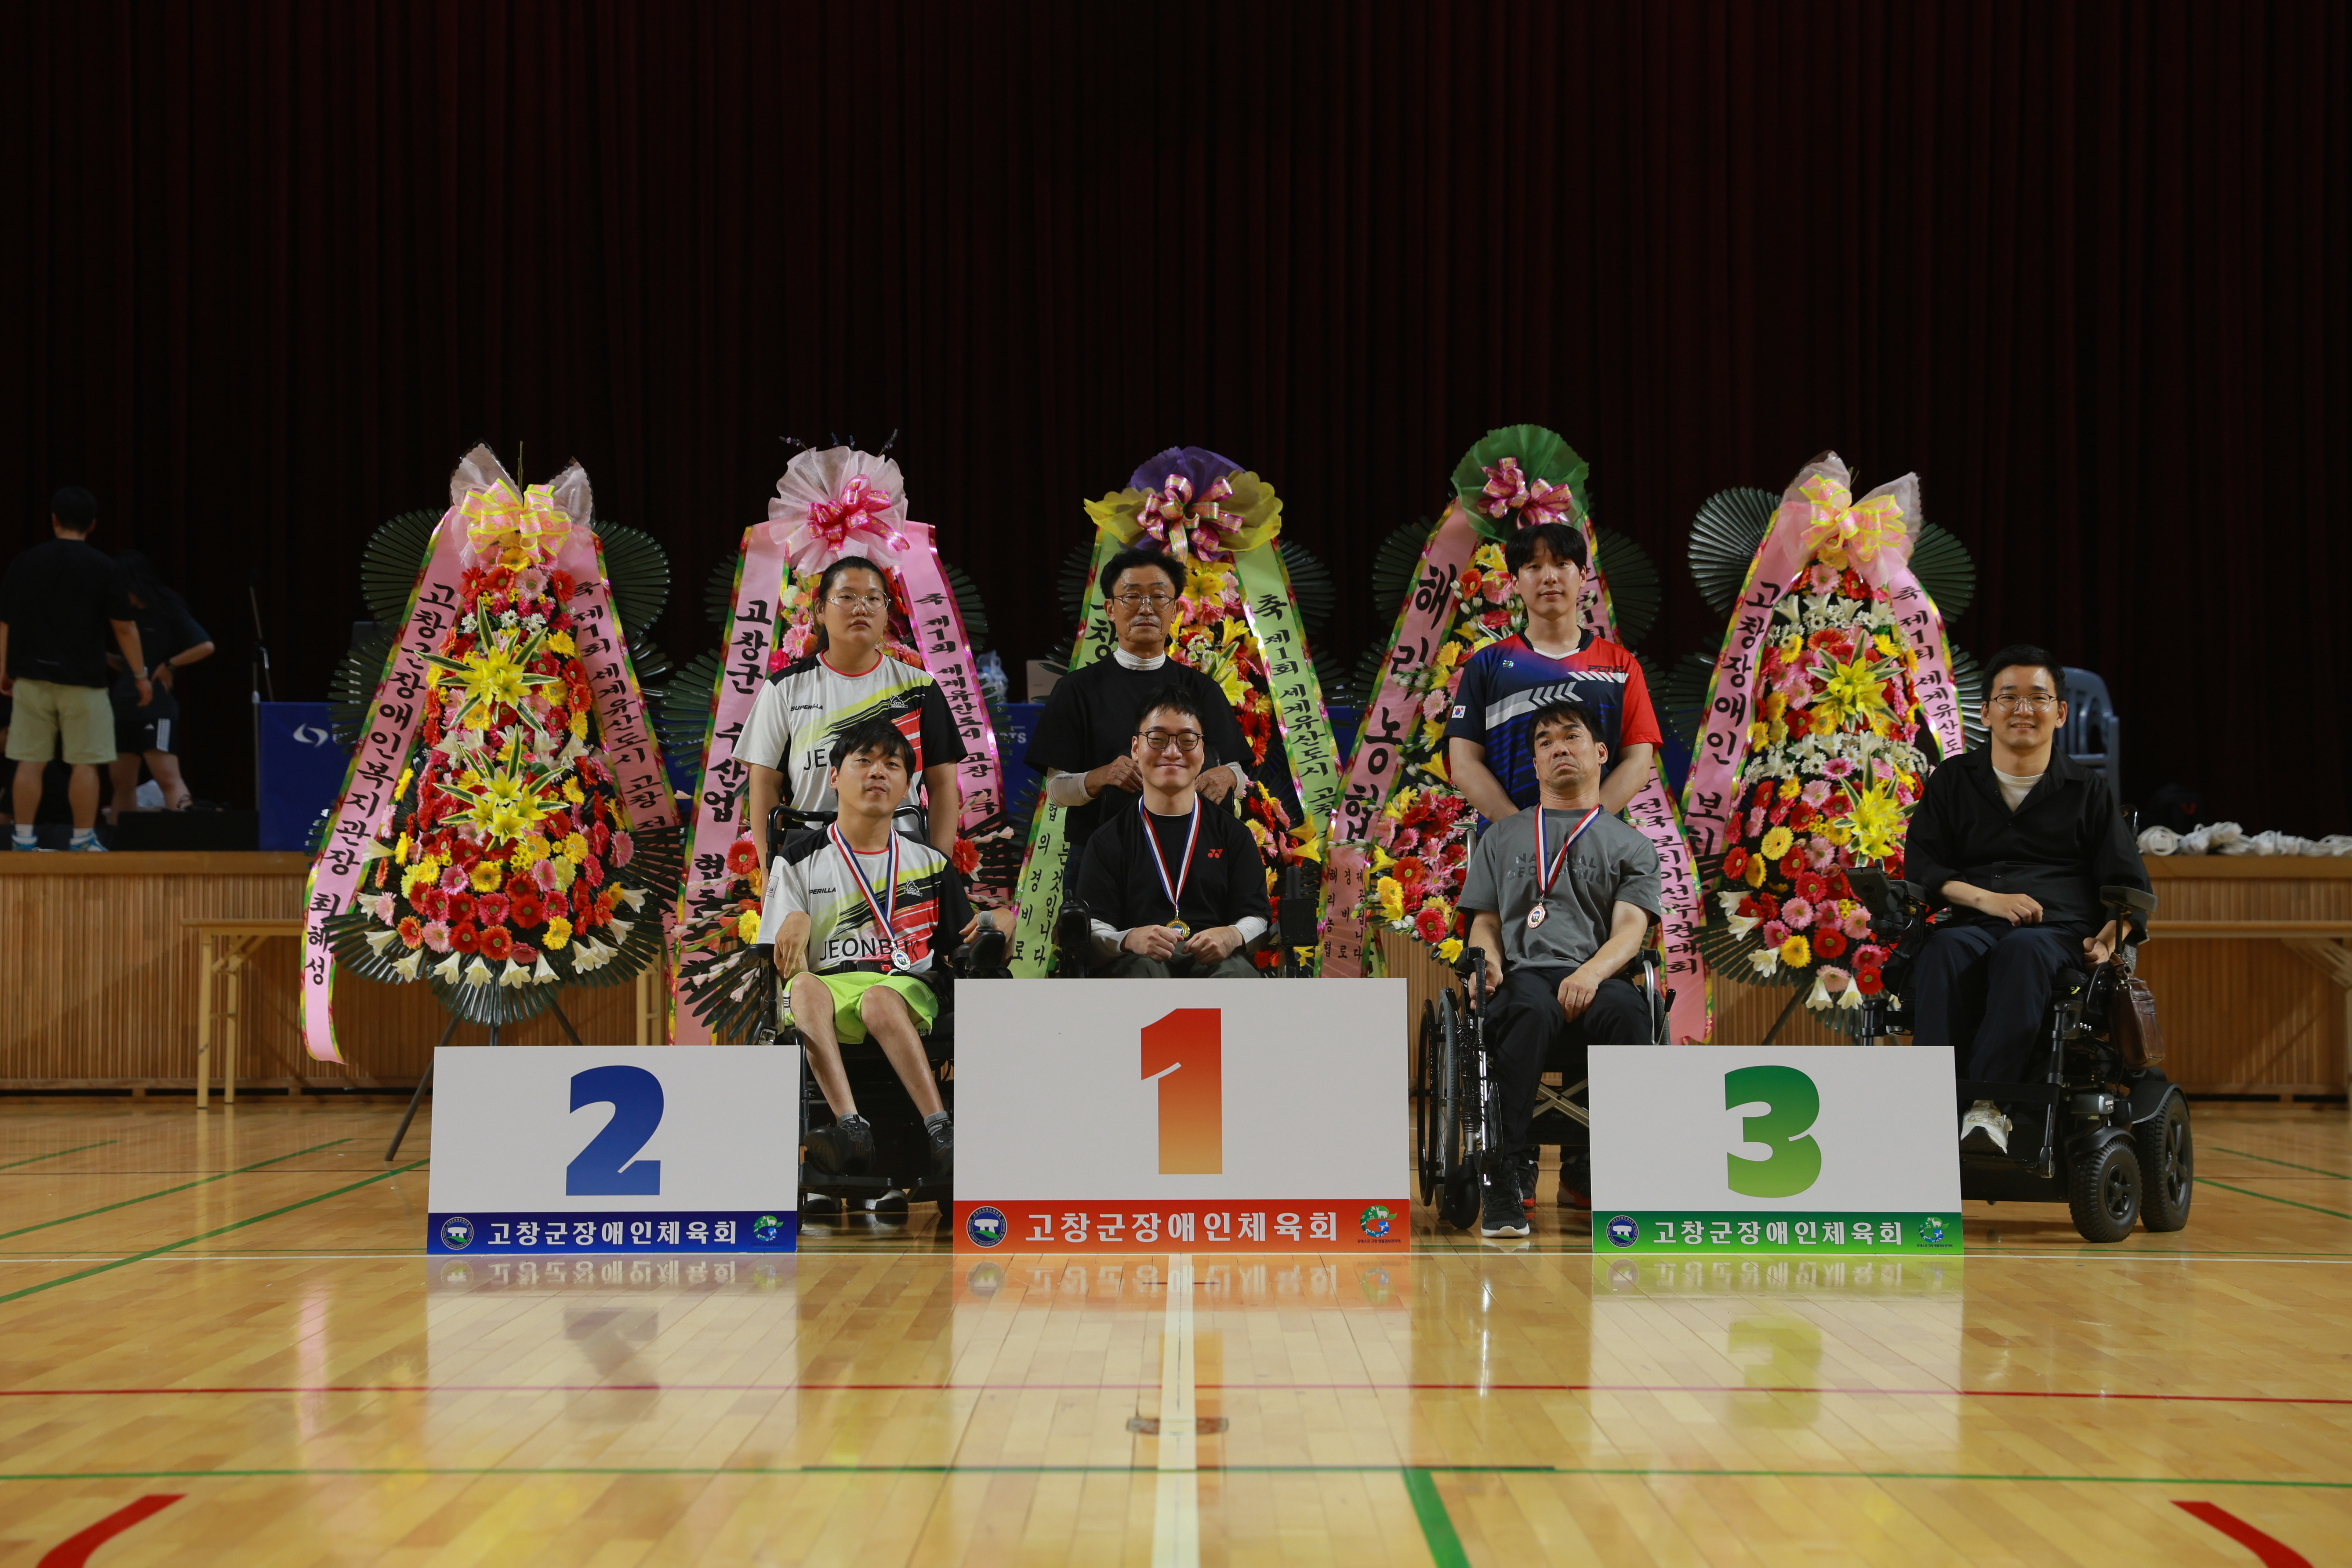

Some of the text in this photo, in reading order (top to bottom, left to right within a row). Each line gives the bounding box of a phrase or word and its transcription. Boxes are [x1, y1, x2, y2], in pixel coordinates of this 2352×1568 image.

[914, 593, 948, 605] 축
[1253, 593, 1288, 620] 축
[1893, 586, 1922, 601] 축
[573, 605, 610, 657] 제1회
[921, 615, 956, 653] 제1회
[1264, 629, 1299, 676] 제1회
[1898, 610, 1934, 661] 제1회
[1706, 581, 1781, 765] 고창장애인
[590, 662, 648, 765] 세계유산도시
[934, 663, 983, 740] 세계유산도시
[1345, 563, 1457, 842] 해리농협
[324, 583, 456, 876] 고창군장애인복지관장
[1279, 683, 1330, 777] 세계유산도시
[704, 722, 746, 822] 수산업
[959, 752, 993, 778] 고창
[624, 775, 663, 808] 고창
[1630, 798, 1674, 828] 전국
[1324, 867, 1338, 958] 해리농협
[1338, 868, 1351, 959] 경비로
[1353, 869, 1366, 962] 제공됩니다
[820, 938, 919, 961] JEONBUK
[1141, 1008, 1223, 1174] 1
[565, 1065, 664, 1196] 2
[1724, 1065, 1822, 1198] 3
[488, 1221, 736, 1244] 고창군장애인체육회
[1025, 1212, 1337, 1242] 고창군장애인체육회
[1653, 1221, 1902, 1245] 고창군장애인체육회
